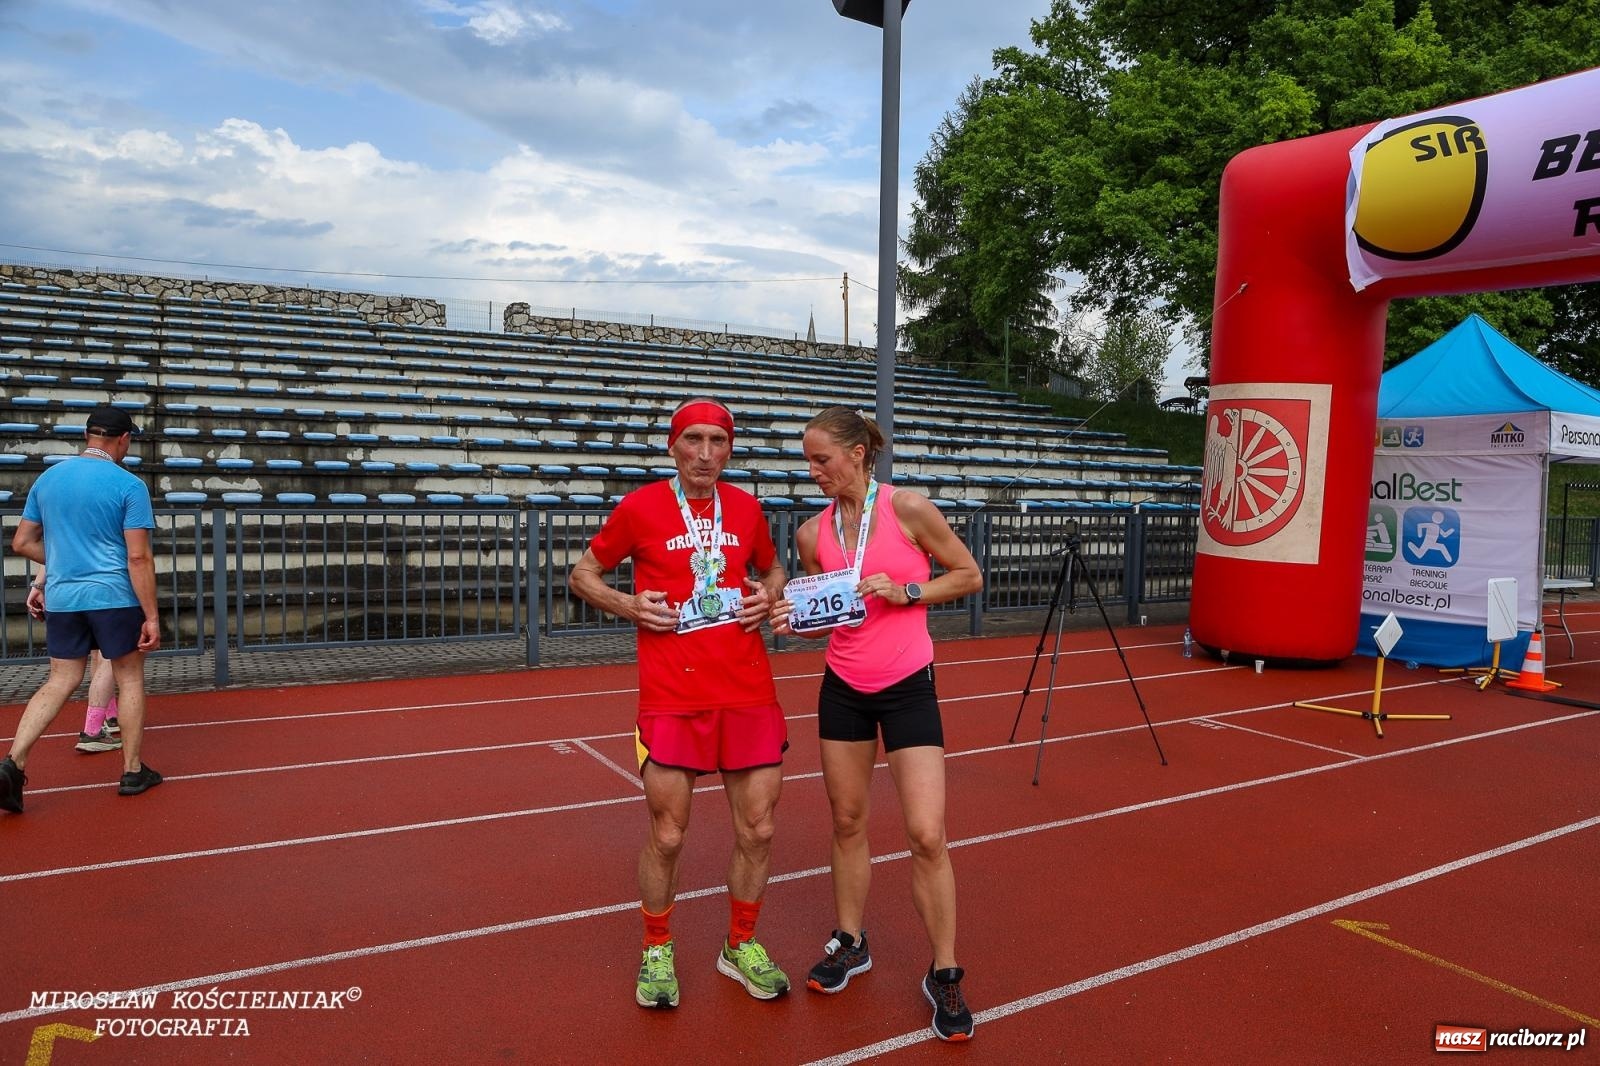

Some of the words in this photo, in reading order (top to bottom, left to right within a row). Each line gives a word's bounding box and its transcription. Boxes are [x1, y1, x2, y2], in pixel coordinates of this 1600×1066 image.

[1411, 126, 1485, 162] SIR
[1491, 433, 1524, 443] MITKO
[1370, 473, 1462, 502] alBest
[801, 577, 816, 585] BIEG
[817, 574, 829, 582] BEZ
[1412, 569, 1447, 579] TRENINGI
[1410, 580, 1448, 590] BIEGOWE
[807, 593, 844, 616] 216
